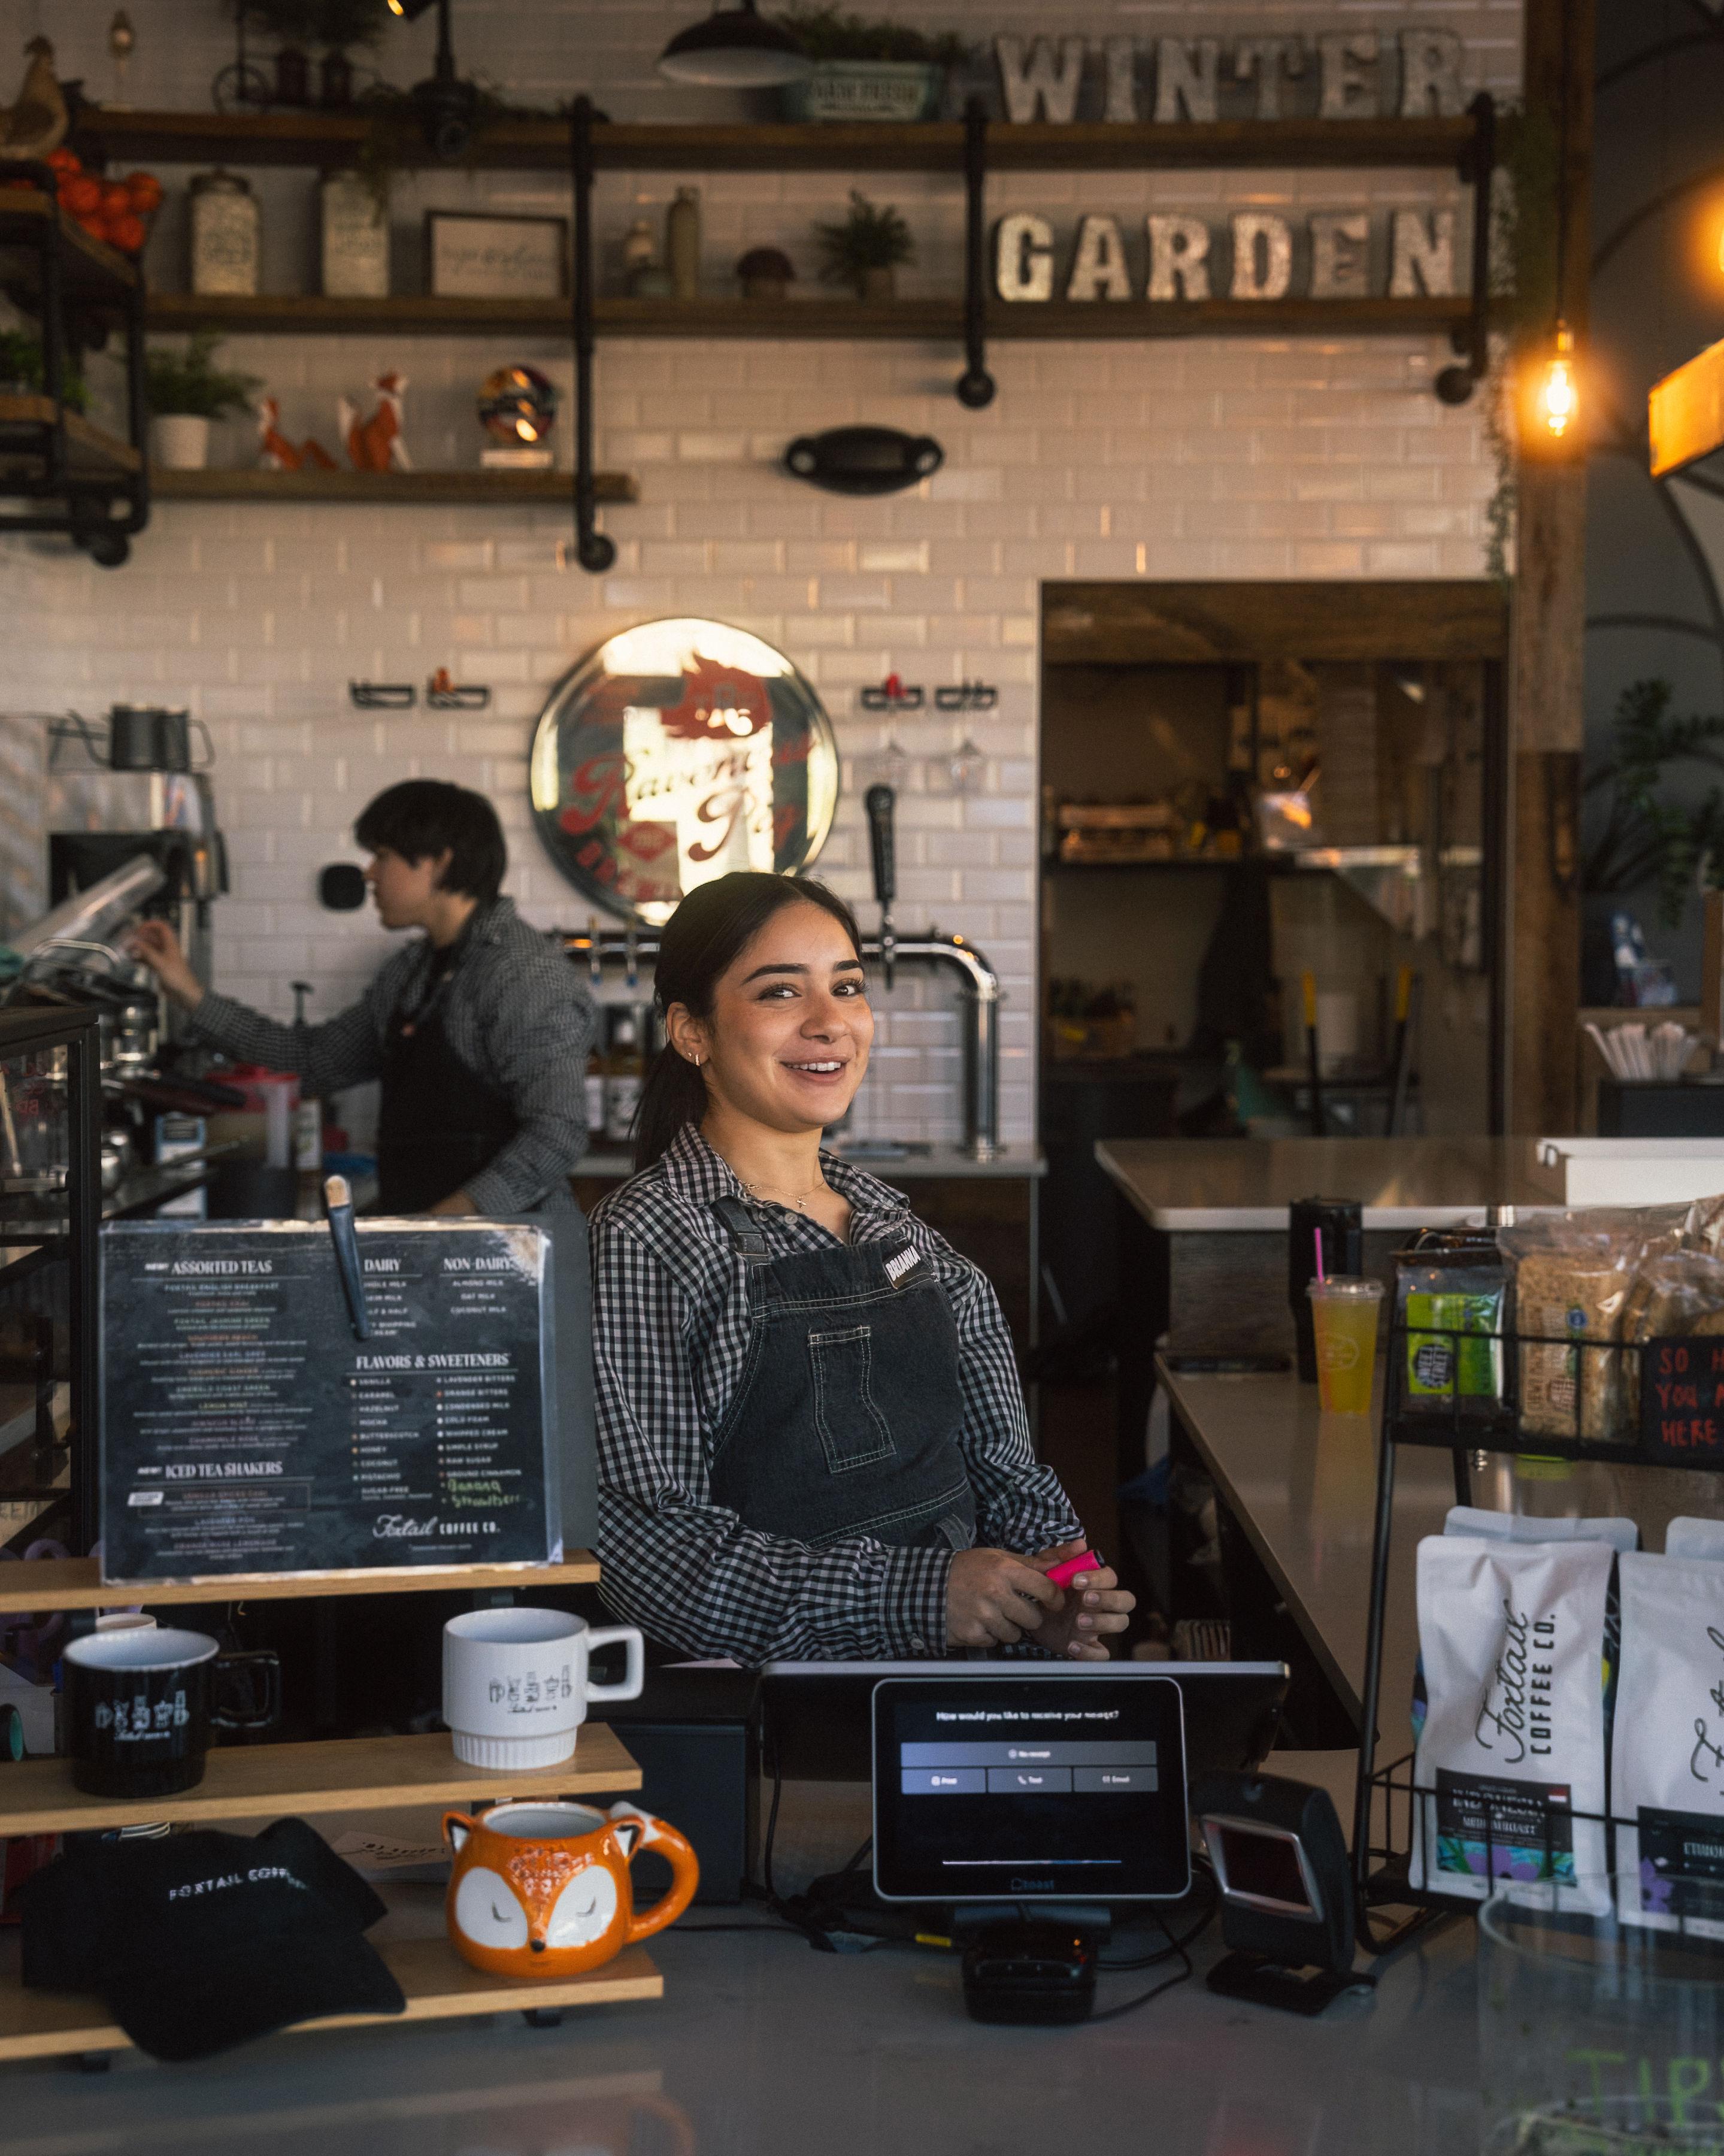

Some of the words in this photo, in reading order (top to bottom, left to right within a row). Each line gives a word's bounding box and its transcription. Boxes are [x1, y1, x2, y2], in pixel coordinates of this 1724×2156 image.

[995, 29, 1464, 125] WINTER
[995, 211, 1456, 303] GARDEN
[171, 1260, 239, 1274] ASSORTED
[241, 1259, 272, 1274] TEAS
[364, 1258, 401, 1272] DAIRY
[885, 1245, 921, 1282] BRIANNA
[356, 1355, 412, 1370] FLAVORS
[414, 1354, 426, 1368] &
[427, 1352, 510, 1368] SWEETENERS
[1658, 1347, 1689, 1374] SO
[1661, 1418, 1719, 1448] HERE
[165, 1463, 196, 1479] ICED
[198, 1462, 223, 1478] TEA
[224, 1461, 283, 1477] SHAKERS
[372, 1514, 438, 1539] Foxtail
[439, 1522, 478, 1535] COFFEE
[482, 1521, 501, 1534] CO.
[1534, 1614, 1556, 1649] CO.
[1475, 1598, 1529, 1764] Foxtail
[936, 1712, 957, 1721] How
[958, 1711, 986, 1721] would
[986, 1712, 1002, 1722] you
[1003, 1711, 1019, 1720] like
[1020, 1712, 1029, 1720] to
[1064, 1712, 1082, 1721] your
[1530, 1663, 1553, 1755] COFFEE
[168, 1873, 244, 1901] FOXTAIL
[1564, 2048, 1724, 2127] TIP
